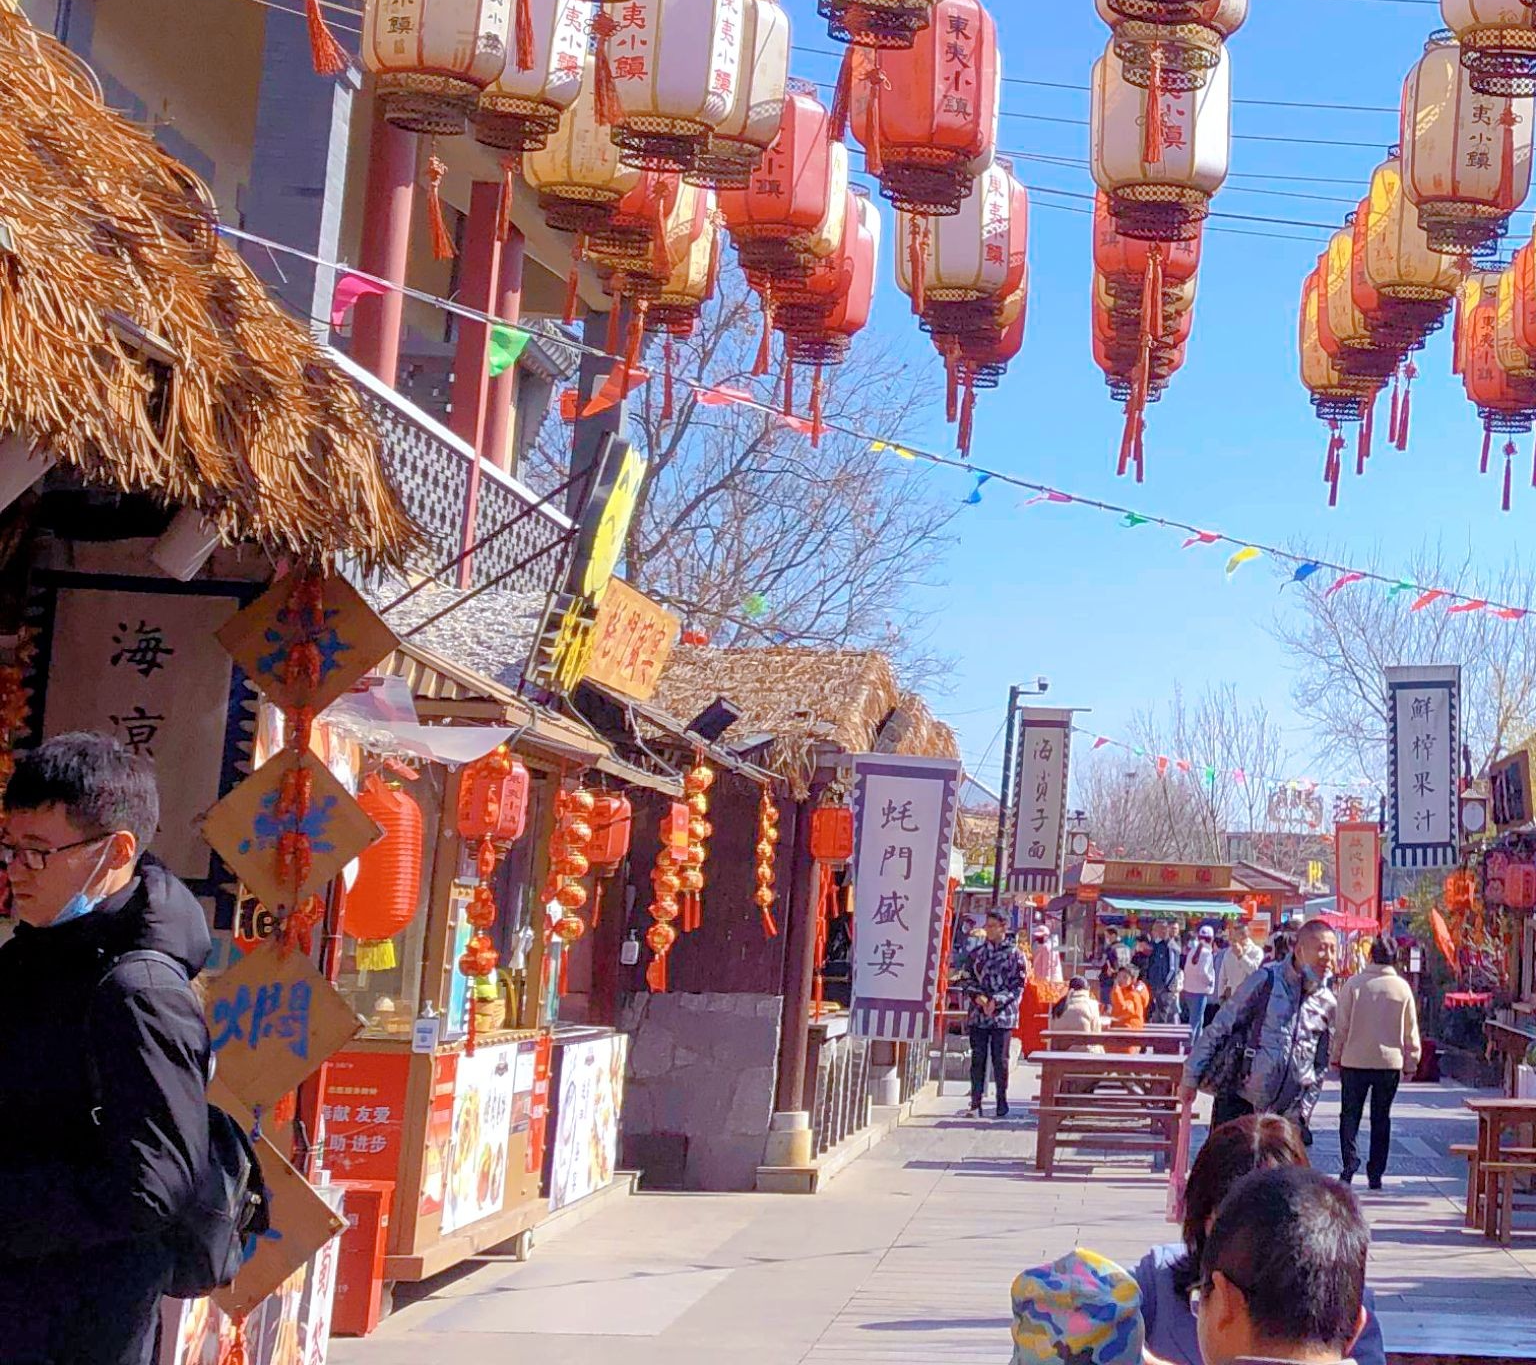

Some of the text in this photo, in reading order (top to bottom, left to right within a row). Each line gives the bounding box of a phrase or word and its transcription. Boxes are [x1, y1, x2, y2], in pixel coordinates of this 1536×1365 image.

[936, 12, 972, 119] 東夷小鎮
[355, 1105, 391, 1124] 友爱
[351, 1134, 388, 1153] 进步
